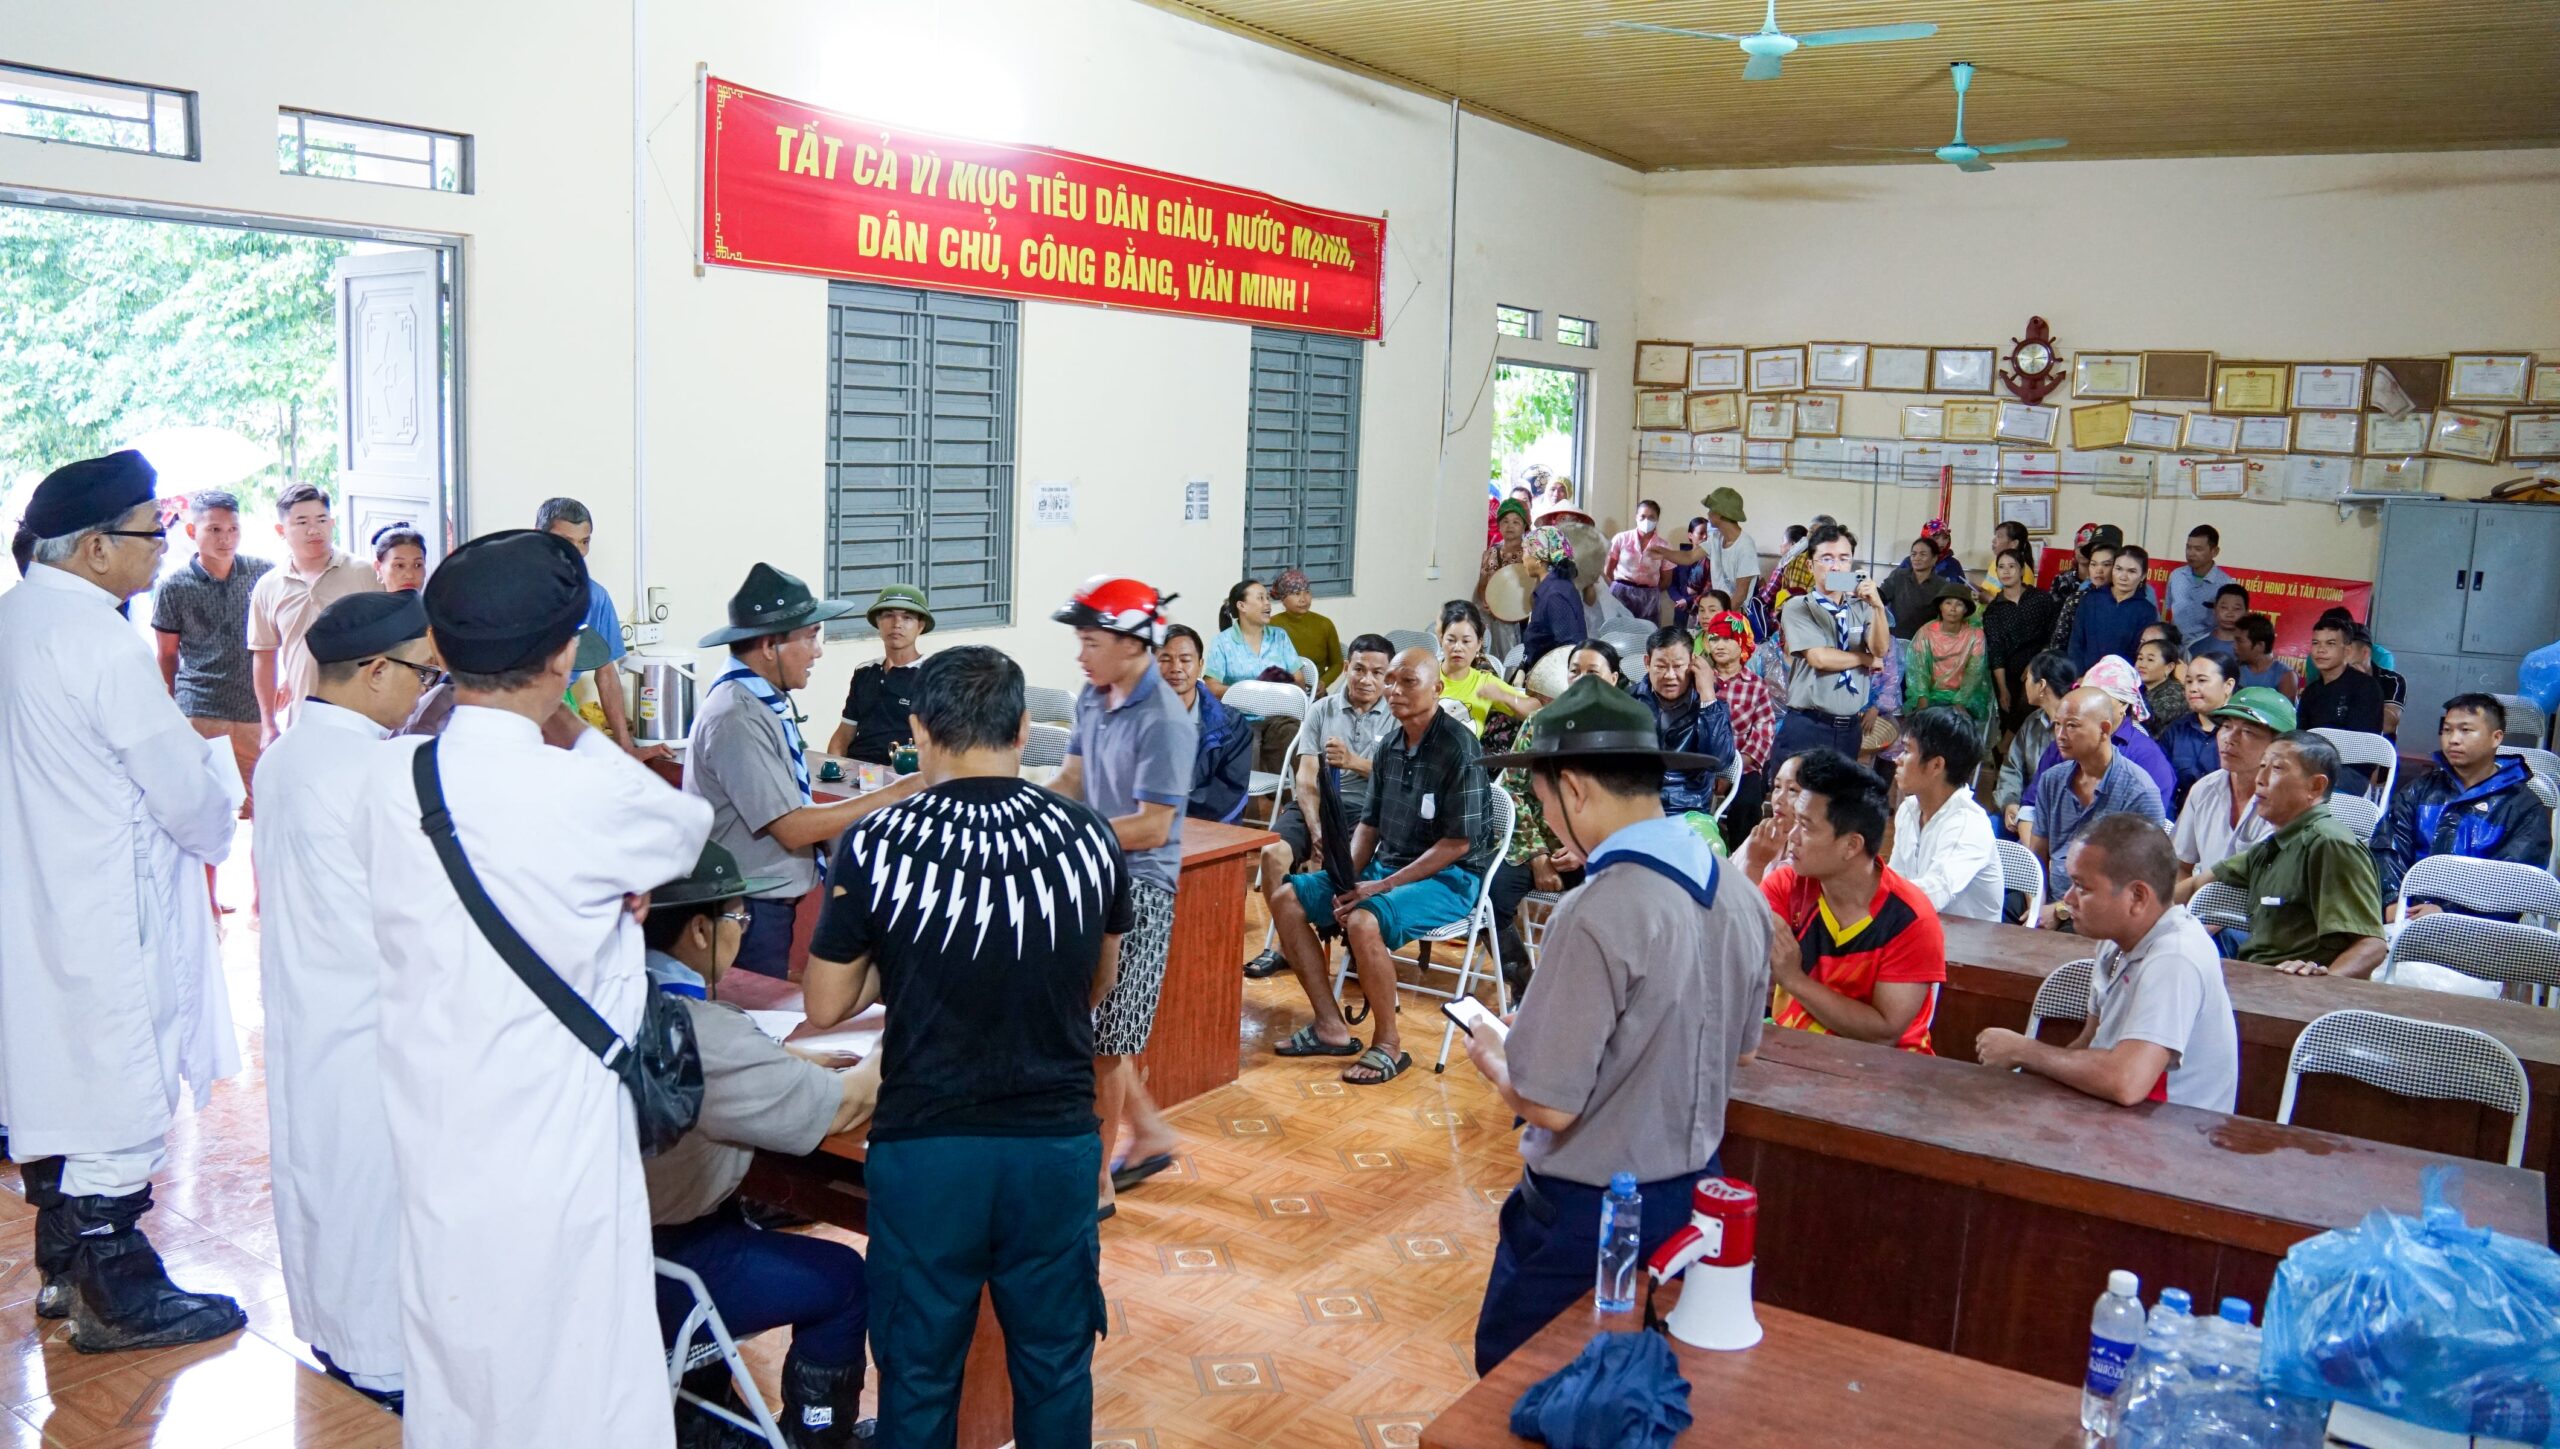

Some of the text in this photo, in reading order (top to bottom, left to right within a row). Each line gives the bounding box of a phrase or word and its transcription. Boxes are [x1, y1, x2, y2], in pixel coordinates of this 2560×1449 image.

[776, 120, 1356, 272] TẤT CẢ VÌ MỤC TIÊU DÂN GIÀU, NƯỚC MẠNH,
[858, 209, 928, 264] DÂN
[938, 216, 1009, 280] CHỦ,
[1019, 233, 1096, 286] CÔNG
[1104, 237, 1180, 301] BẰNG,
[1187, 258, 1233, 304] VĂN
[1240, 272, 1296, 312] MINH
[2153, 567, 2169, 582] YÊN
[2264, 581, 2286, 596] HĐND
[2287, 582, 2299, 597] XÃ
[2299, 583, 2315, 599] TÂN
